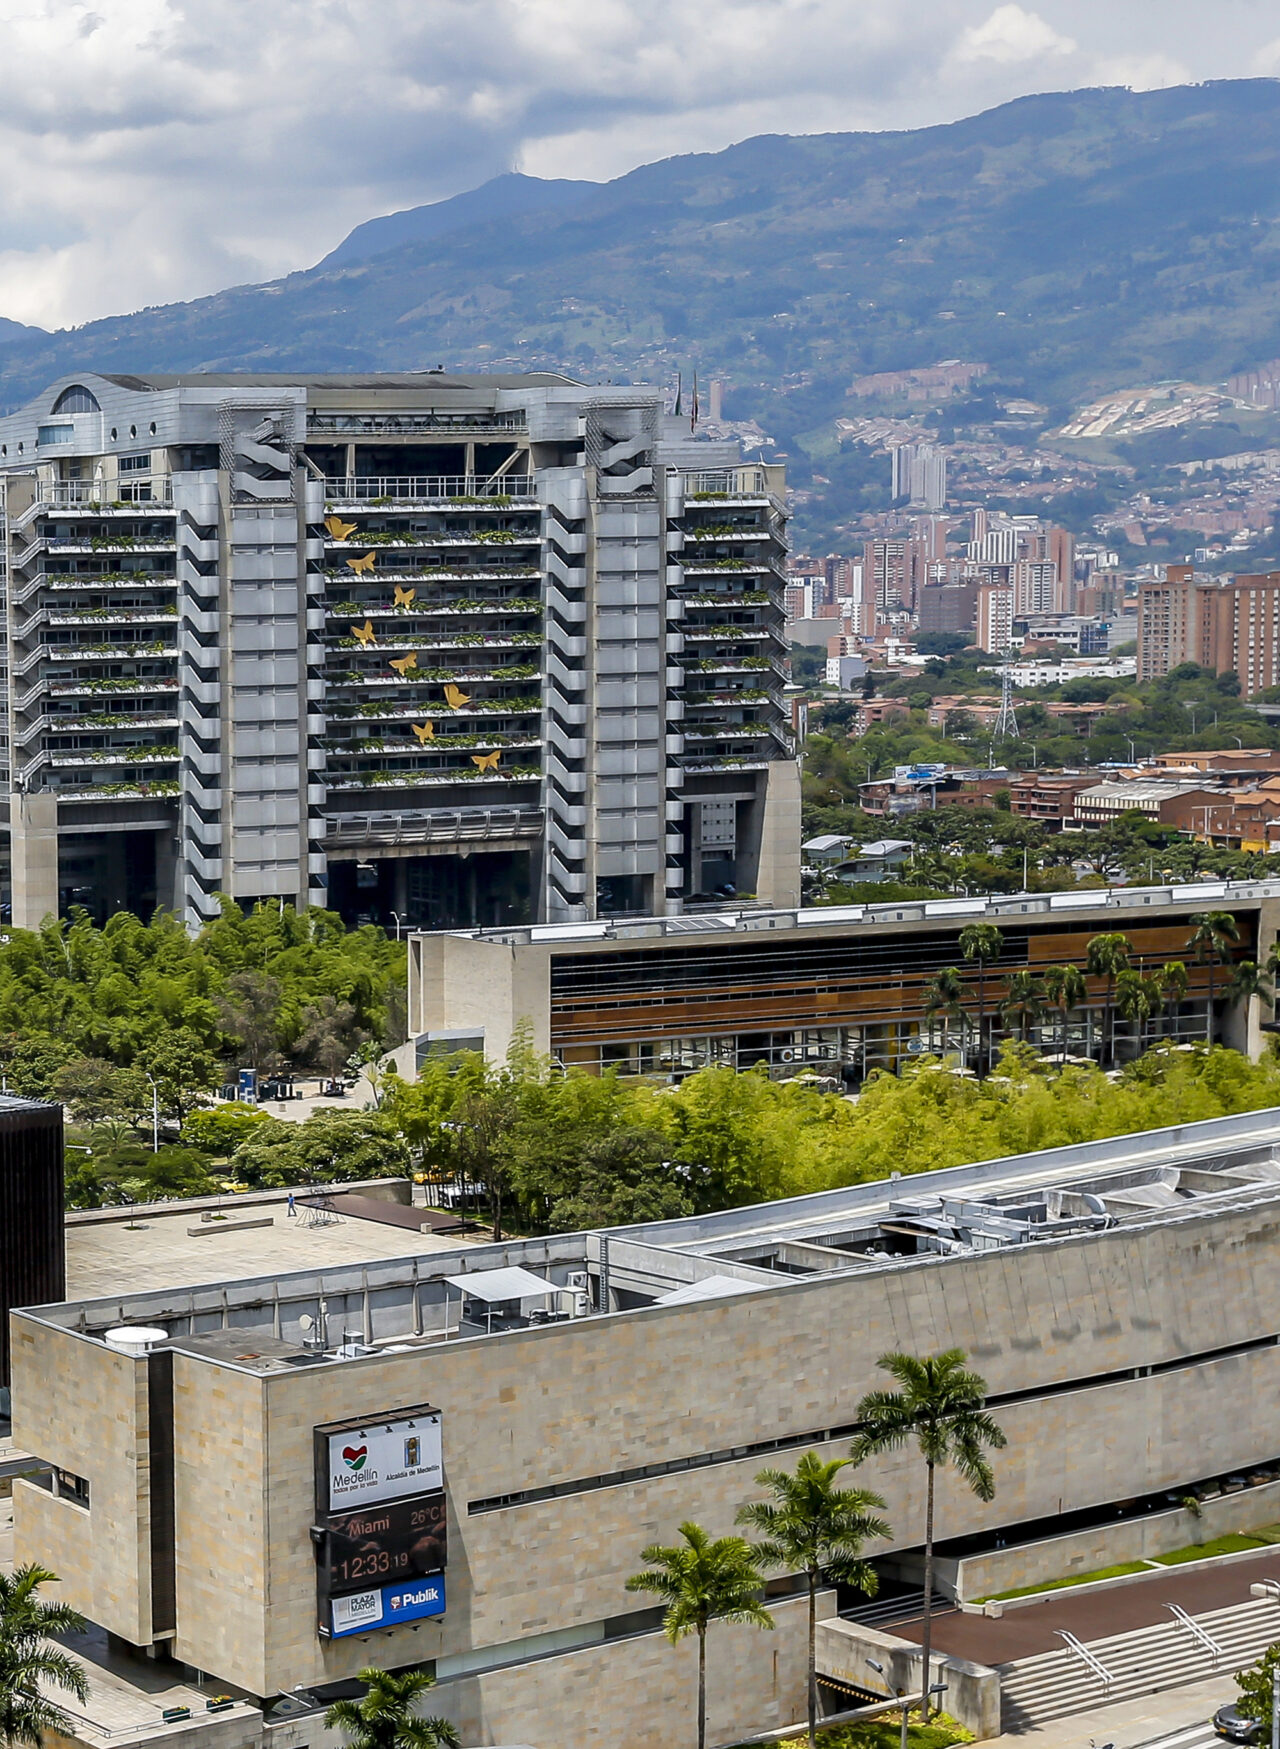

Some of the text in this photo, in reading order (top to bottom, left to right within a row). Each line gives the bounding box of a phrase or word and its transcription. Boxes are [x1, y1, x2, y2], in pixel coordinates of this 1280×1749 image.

[333, 1468, 377, 1488] Medellín
[385, 1464, 440, 1481] Alcaldía de Medellín
[333, 1486, 348, 1494] todos
[350, 1484, 359, 1492] por
[411, 1506, 439, 1525] 26°C
[349, 1515, 390, 1537] Miami
[351, 1594, 375, 1605] PLAZA
[351, 1601, 376, 1612] MAYOR
[403, 1588, 439, 1607] Publik
